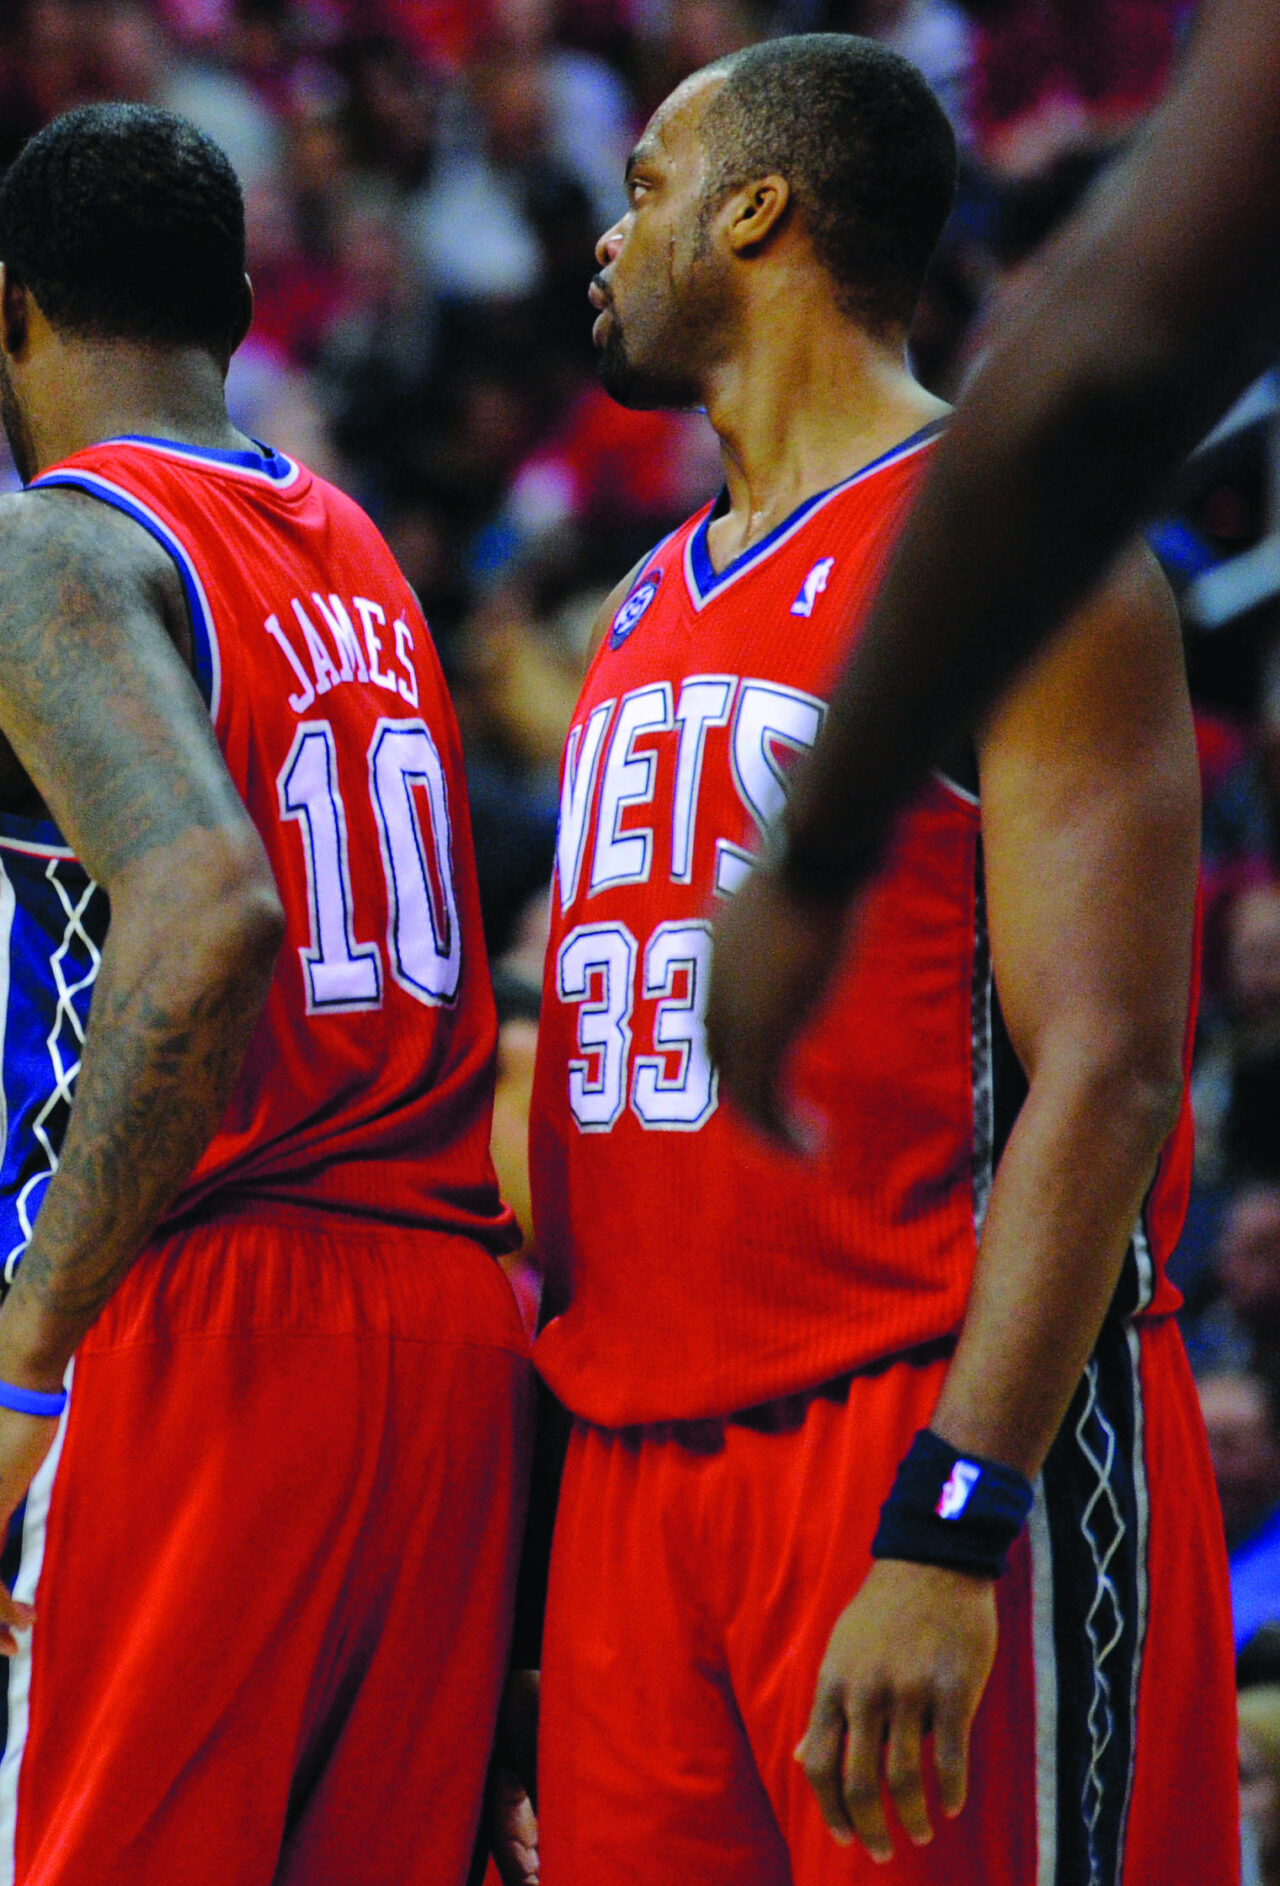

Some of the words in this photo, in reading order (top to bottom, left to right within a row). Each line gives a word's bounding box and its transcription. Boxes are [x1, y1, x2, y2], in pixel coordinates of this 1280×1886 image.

[265, 592, 419, 714] JAMES
[276, 717, 461, 1015] 10
[557, 920, 719, 1134] 33
